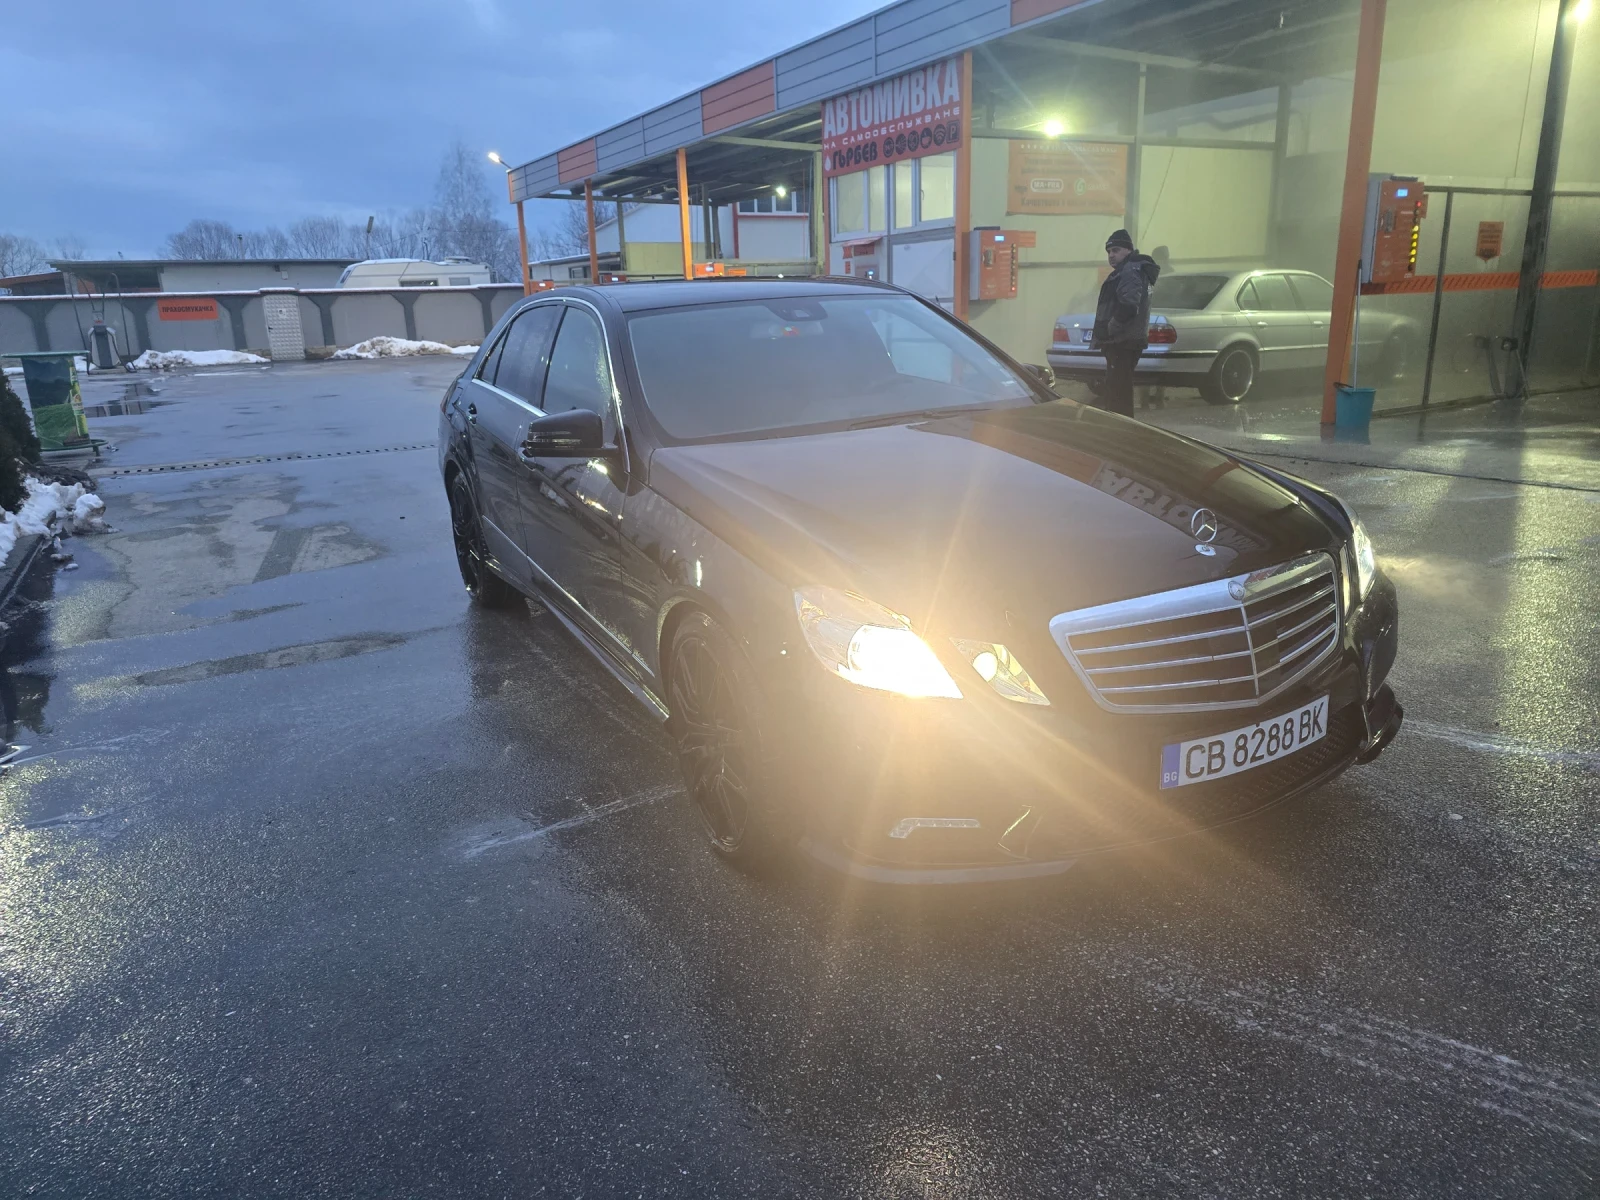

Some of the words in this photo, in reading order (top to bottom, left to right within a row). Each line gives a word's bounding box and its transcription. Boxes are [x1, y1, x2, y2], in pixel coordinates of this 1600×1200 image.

[823, 58, 960, 139] АВТОМИВКА
[823, 142, 836, 150] НА
[842, 107, 960, 145] САМООБСЛУЖВАНЕ
[1185, 739, 1226, 779] CB
[1233, 717, 1295, 768] 8288
[1298, 702, 1324, 745] BK
[1163, 771, 1177, 783] BG
